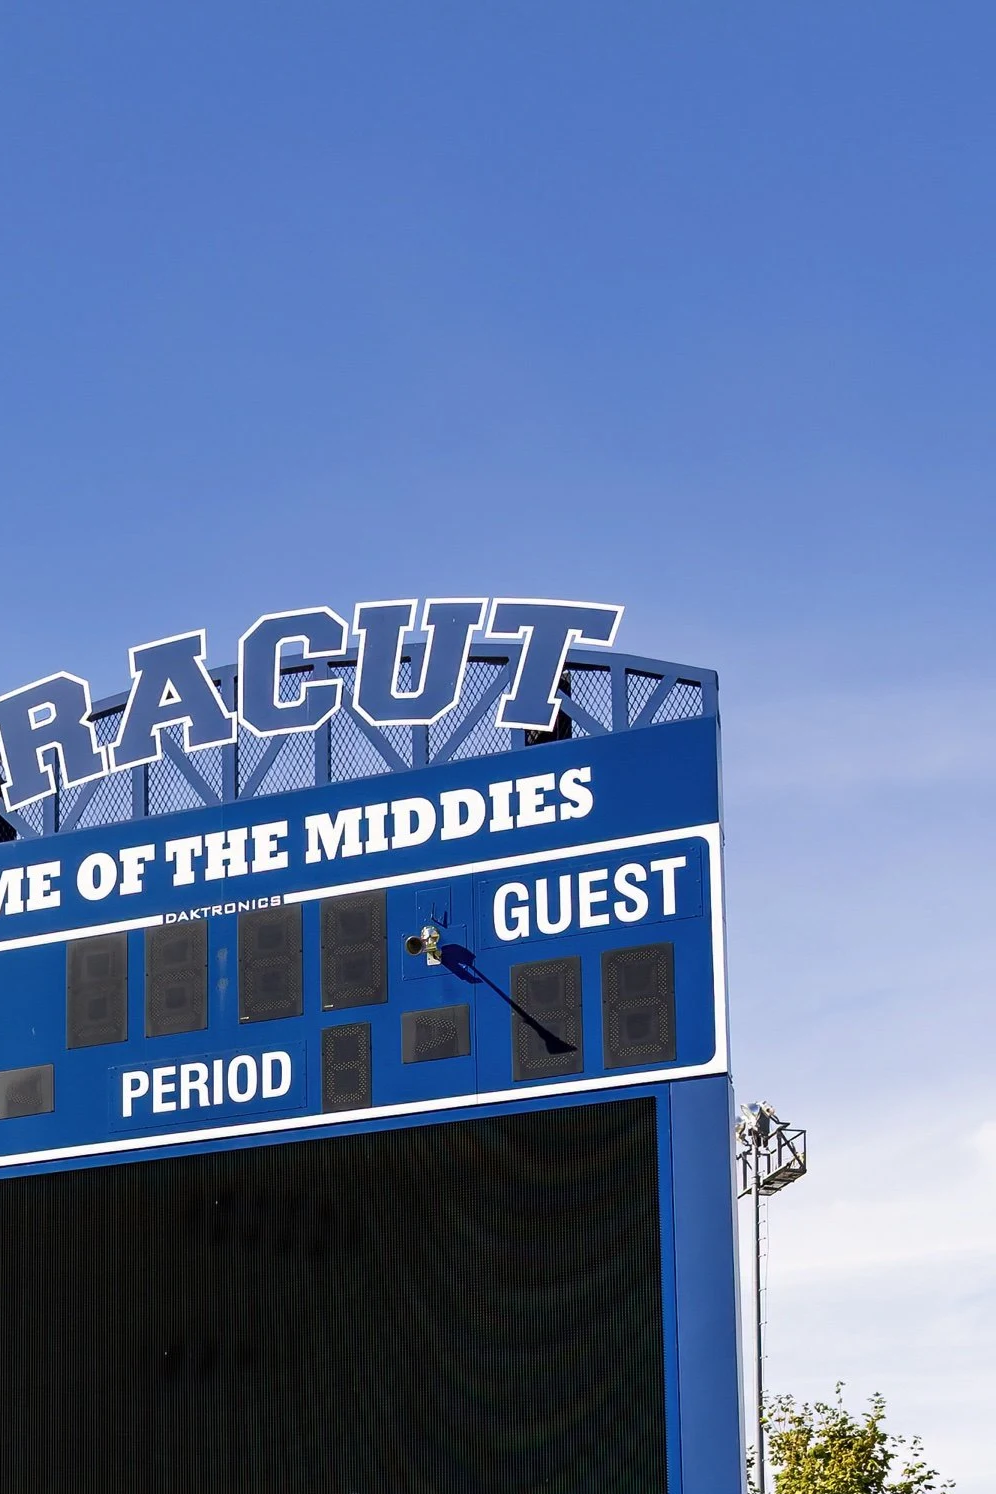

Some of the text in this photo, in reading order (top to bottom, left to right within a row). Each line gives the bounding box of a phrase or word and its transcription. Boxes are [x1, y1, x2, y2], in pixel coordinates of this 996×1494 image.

[77, 845, 155, 901] OF
[166, 821, 288, 887] THE
[305, 767, 593, 864] MIDDIES
[165, 895, 281, 924] DAKTRONICS
[493, 857, 685, 941] GUEST
[122, 1052, 292, 1118] PERIOD
